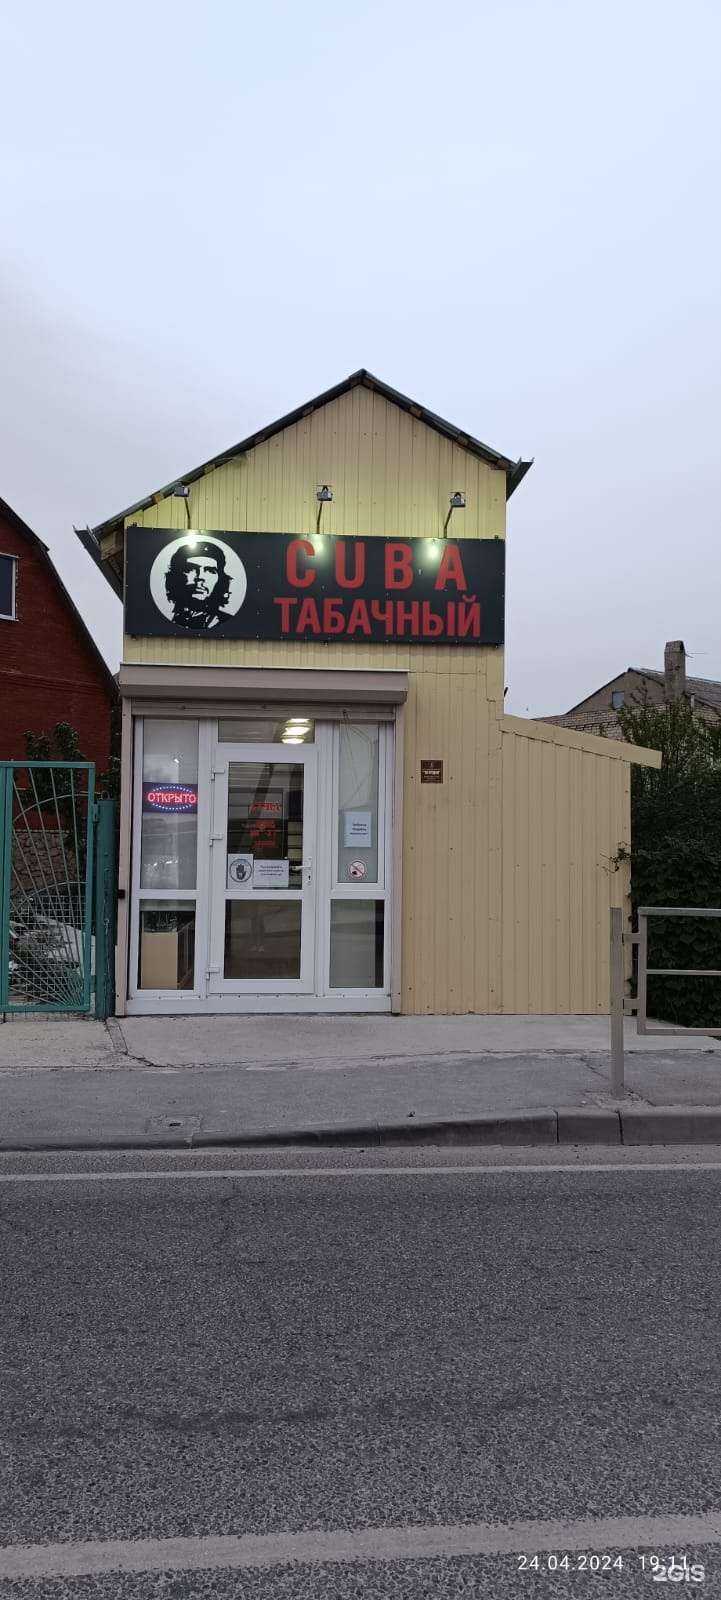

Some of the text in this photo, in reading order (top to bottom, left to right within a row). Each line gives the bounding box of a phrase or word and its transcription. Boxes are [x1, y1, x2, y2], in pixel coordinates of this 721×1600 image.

[285, 539, 468, 591] CUBA
[273, 594, 481, 638] ТАБАЧНЫЙ
[147, 791, 197, 804] ОТКРЫТО
